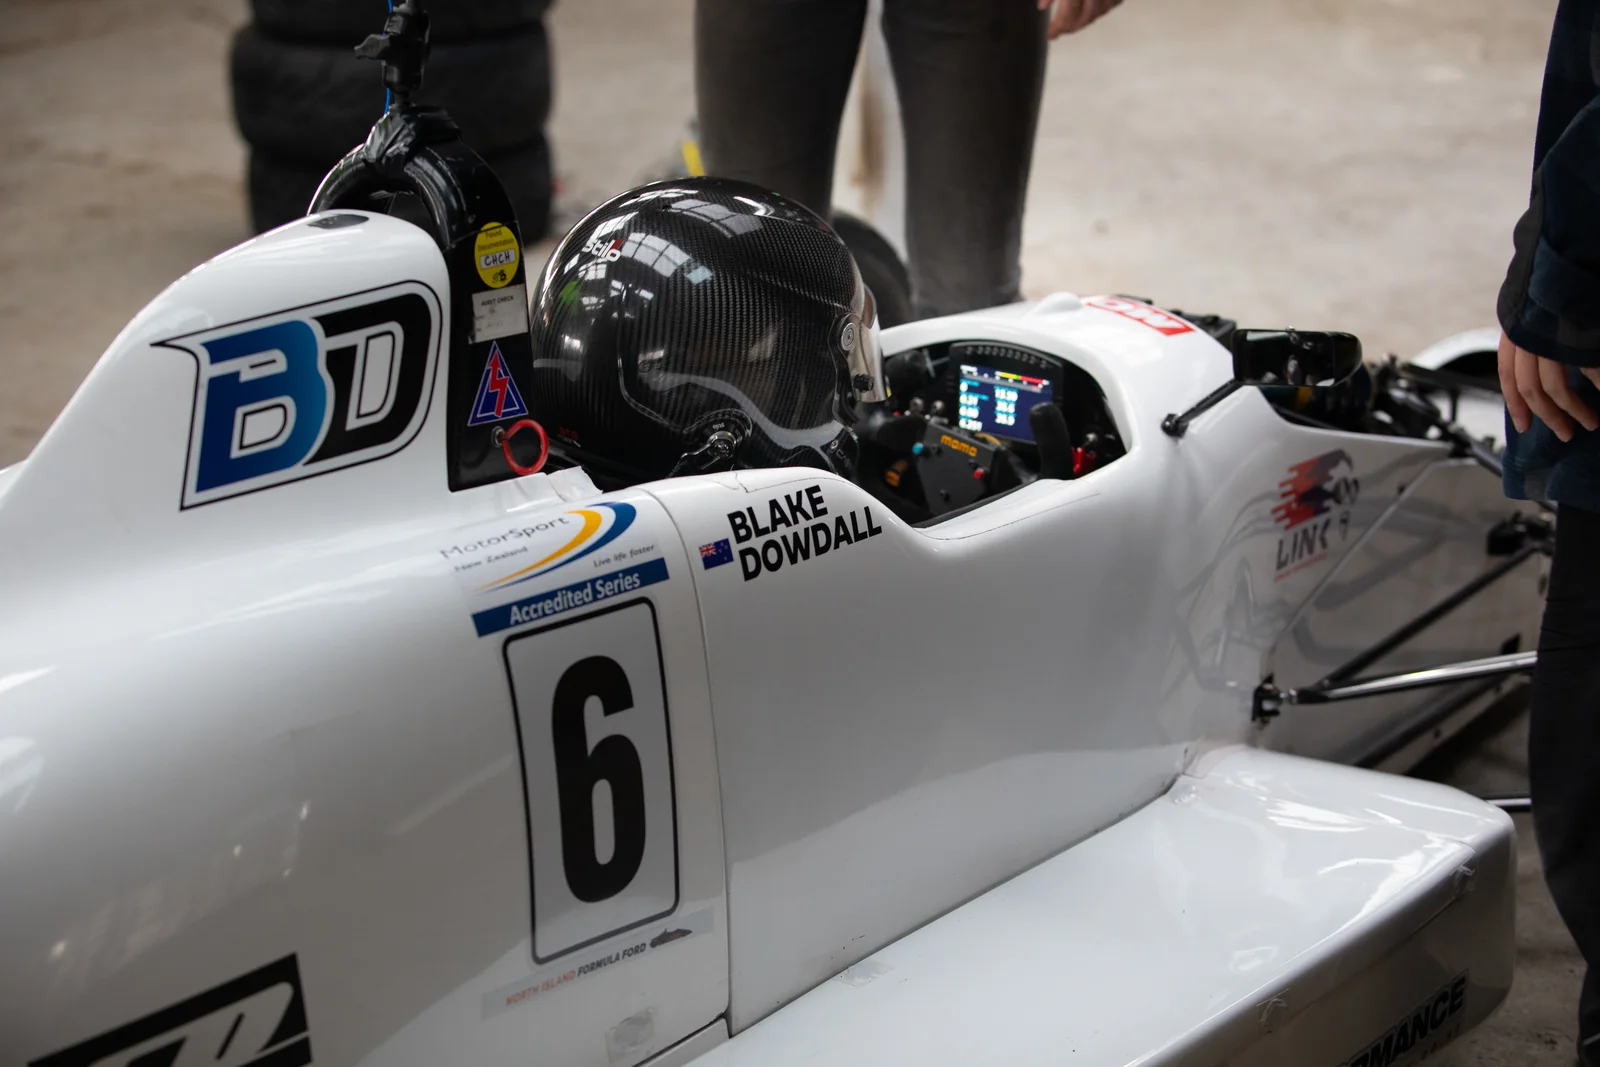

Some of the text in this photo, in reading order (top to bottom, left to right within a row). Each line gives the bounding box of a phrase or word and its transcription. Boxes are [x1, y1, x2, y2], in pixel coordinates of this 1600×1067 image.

[484, 250, 511, 266] CHCH
[195, 293, 432, 493] BD
[439, 515, 570, 560] MotorSport
[727, 484, 829, 545] BLAKE
[738, 505, 883, 582] DOWDALL
[453, 545, 529, 573] New Zealand
[593, 556, 612, 569] Live
[613, 551, 628, 562] life
[509, 570, 641, 625] Accredited Series
[551, 655, 647, 903] 6
[505, 942, 647, 1006] NORTH ISLAND FORMULA FORD
